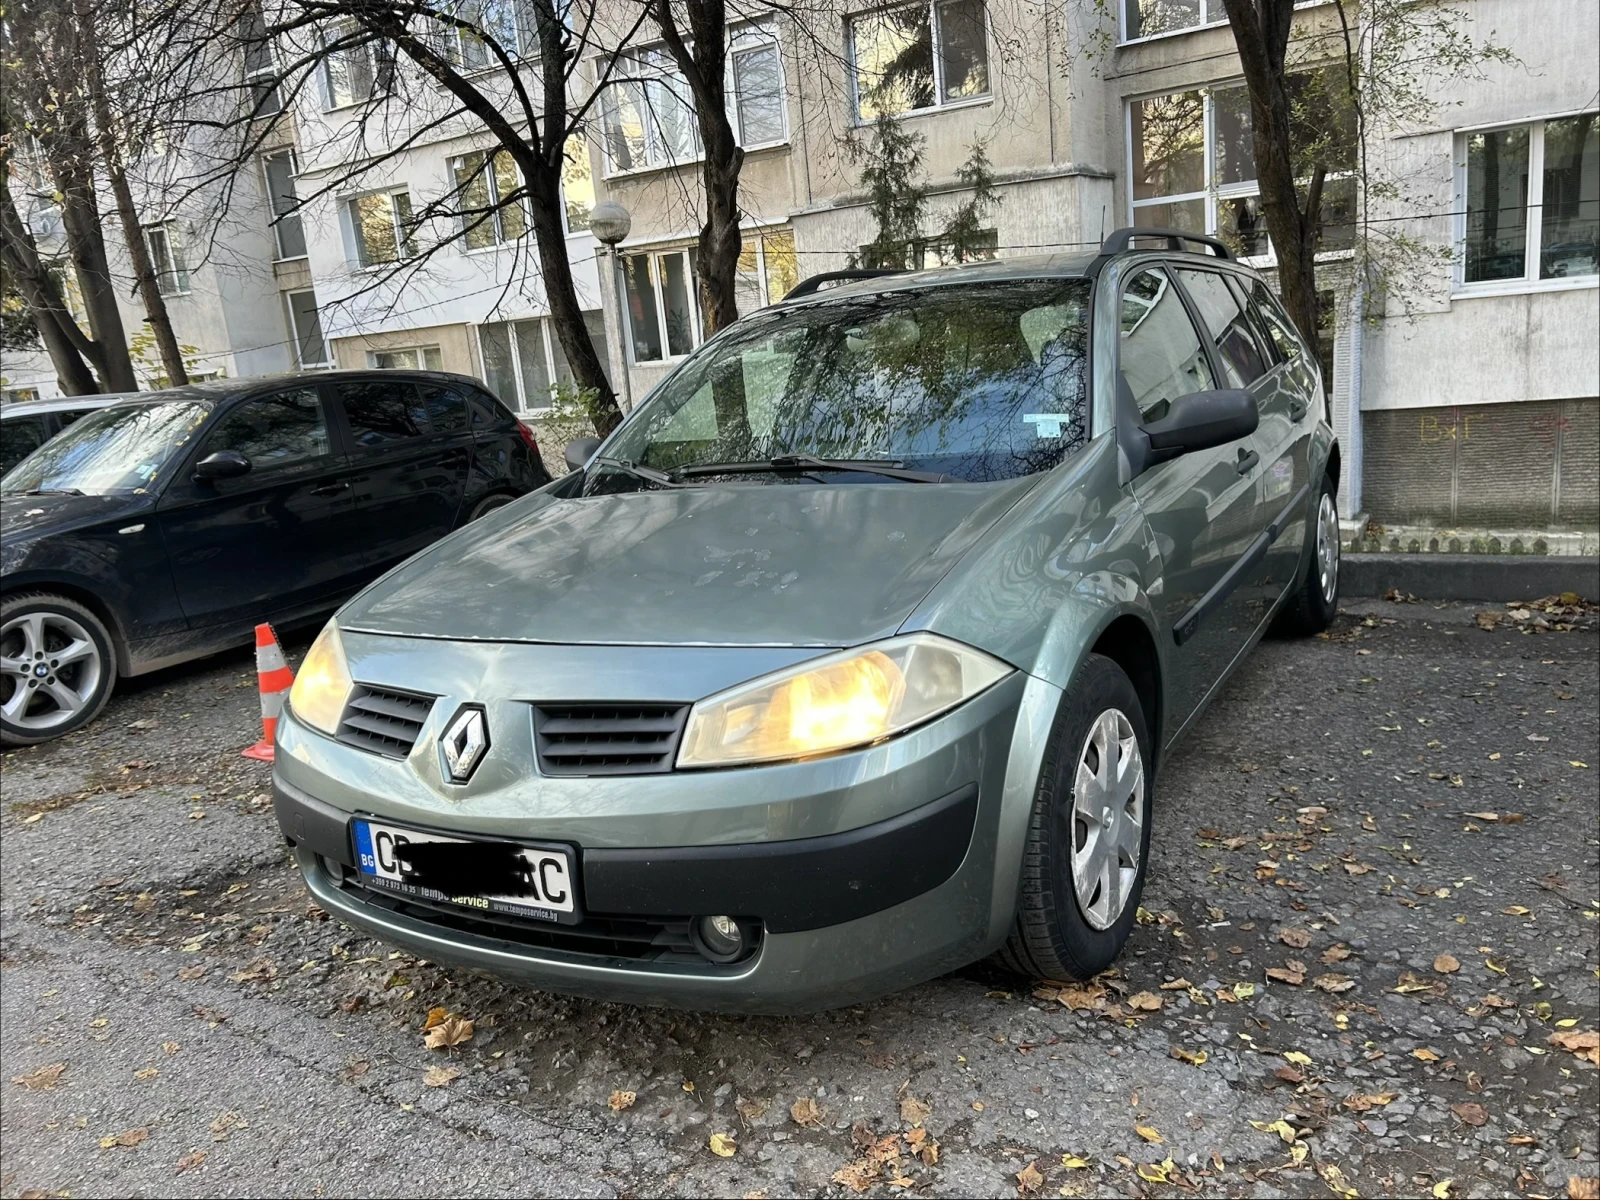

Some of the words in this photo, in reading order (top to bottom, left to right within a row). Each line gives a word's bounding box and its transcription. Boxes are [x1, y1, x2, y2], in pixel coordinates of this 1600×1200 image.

[361, 853, 374, 868] BG
[372, 877, 385, 886] +359
[493, 902, 558, 922] www.temposervice.bg
